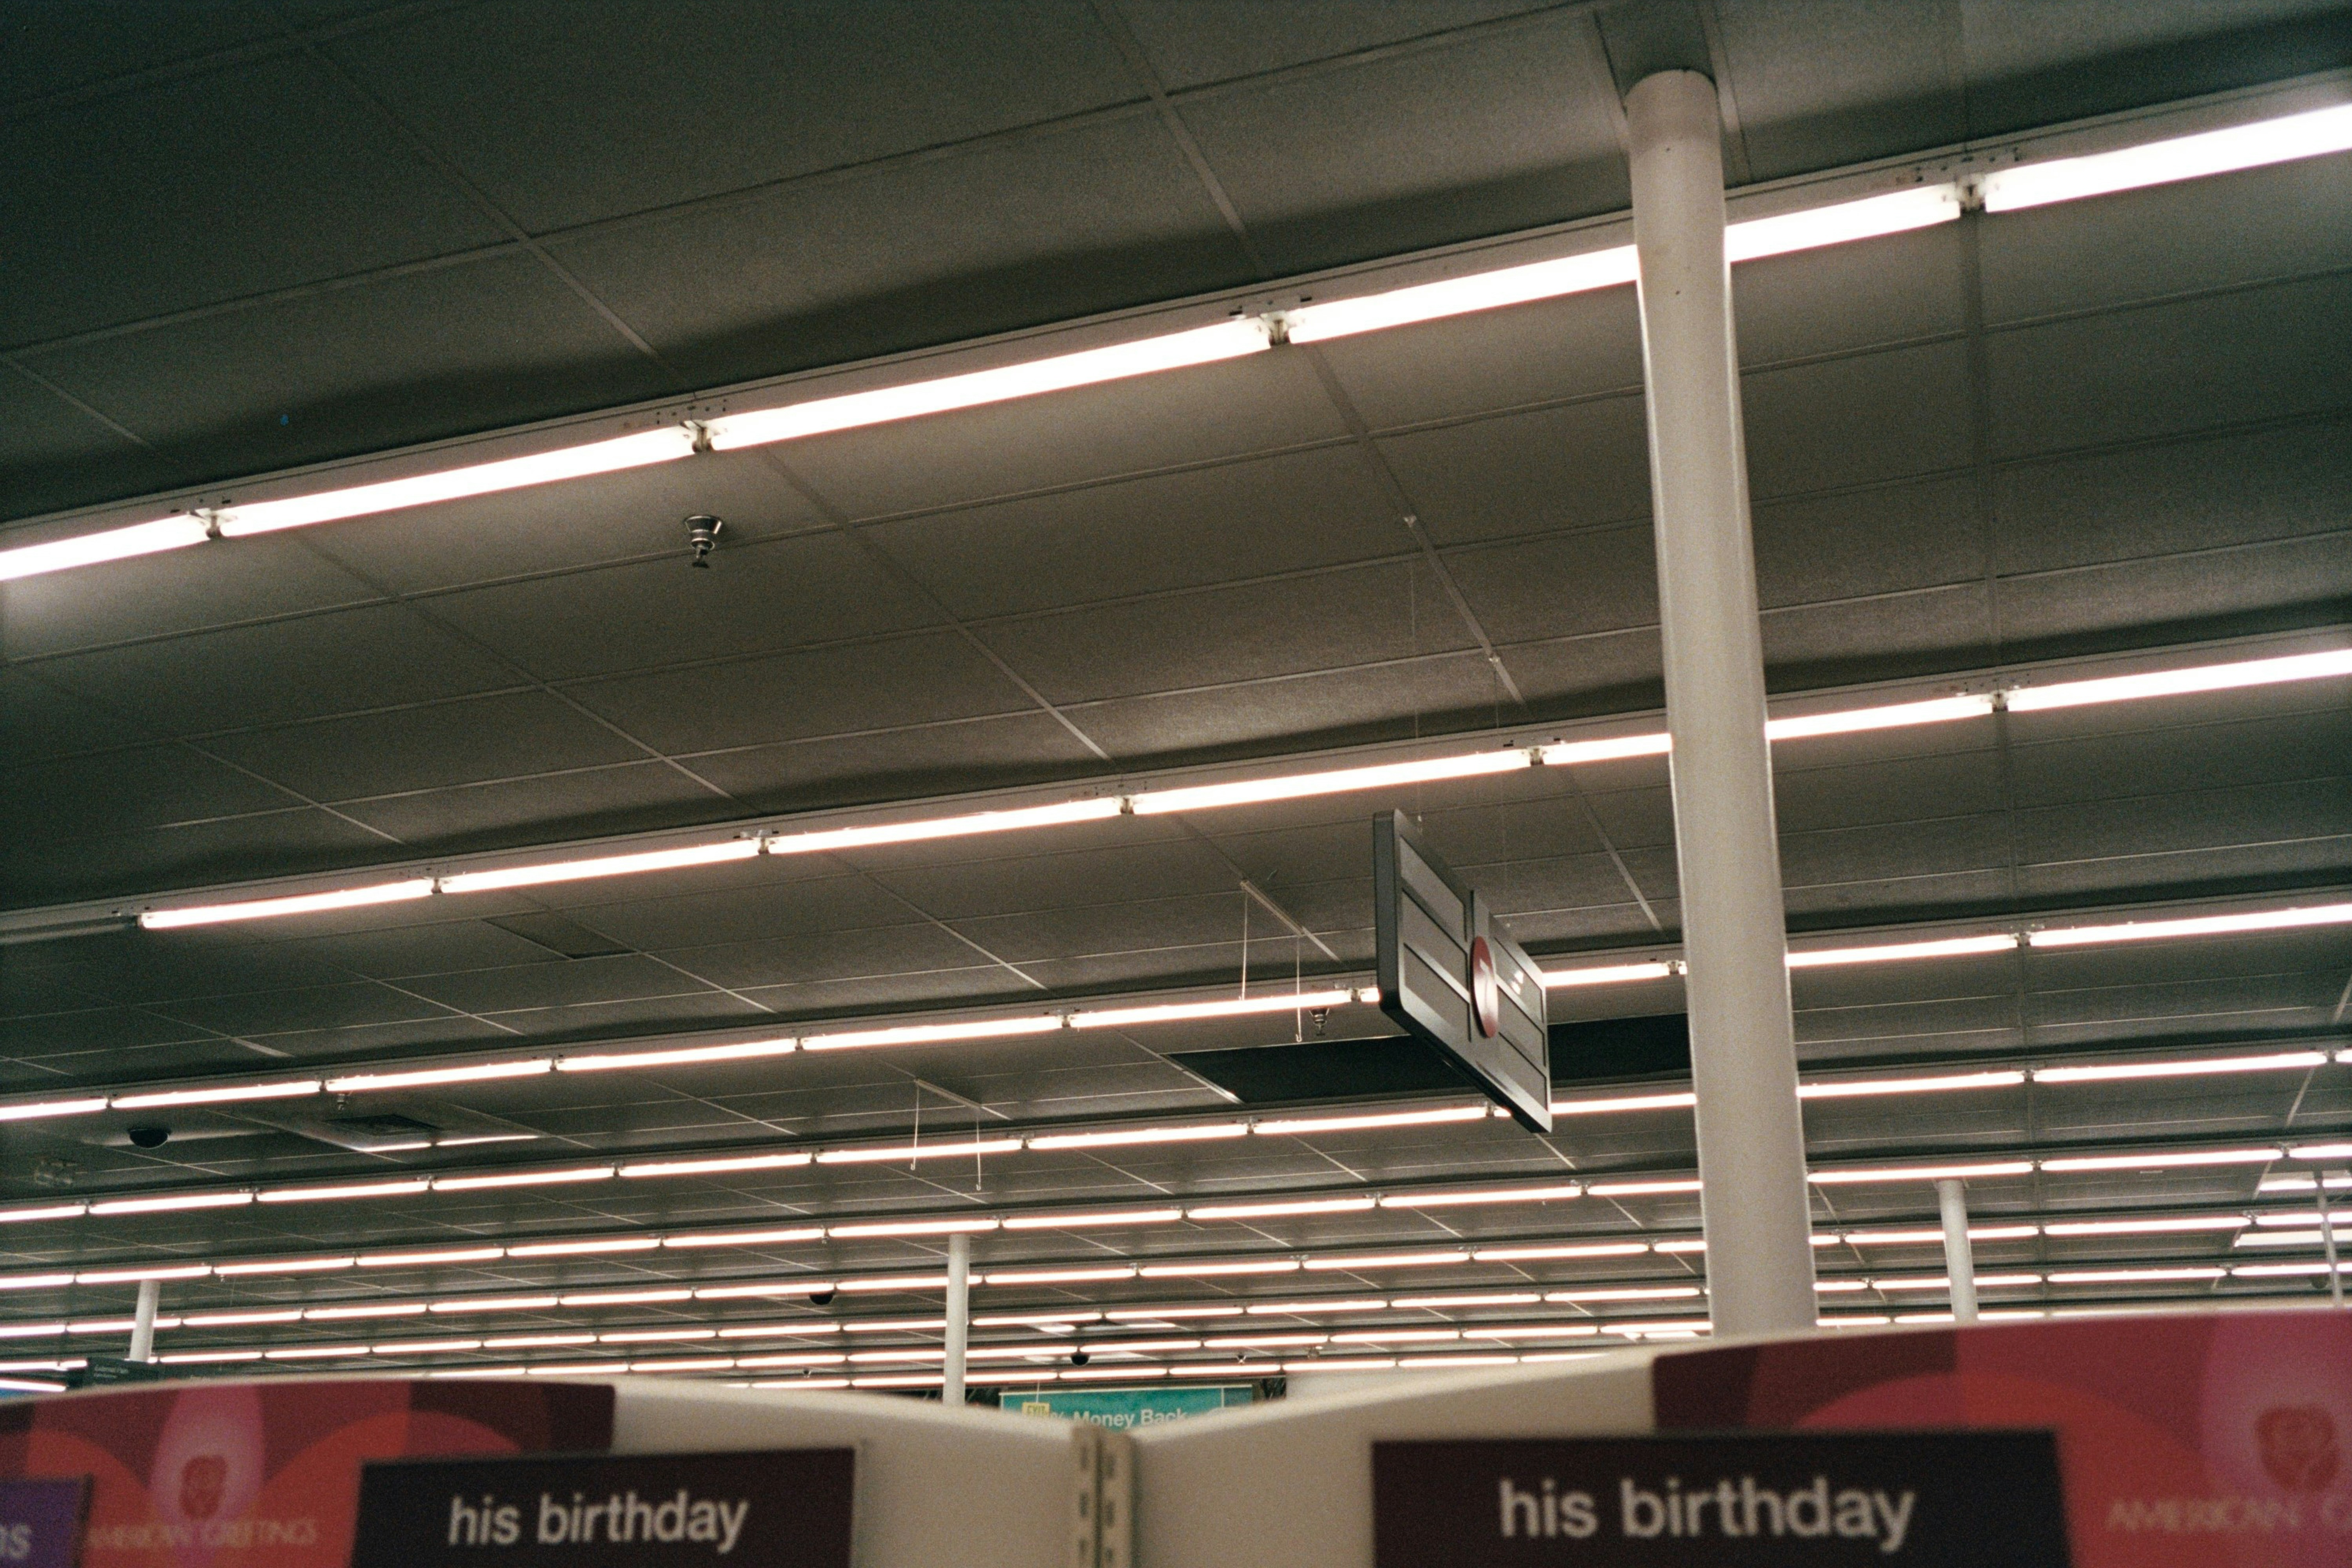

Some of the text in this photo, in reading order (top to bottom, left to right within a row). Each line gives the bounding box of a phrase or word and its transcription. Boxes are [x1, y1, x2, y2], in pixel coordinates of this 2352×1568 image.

[1027, 1405, 1045, 1415] EXIT
[1073, 1411, 1134, 1429] Money
[1141, 1408, 1187, 1425] Back
[448, 1490, 749, 1553] his birthday
[1499, 1475, 1916, 1553] his birthday
